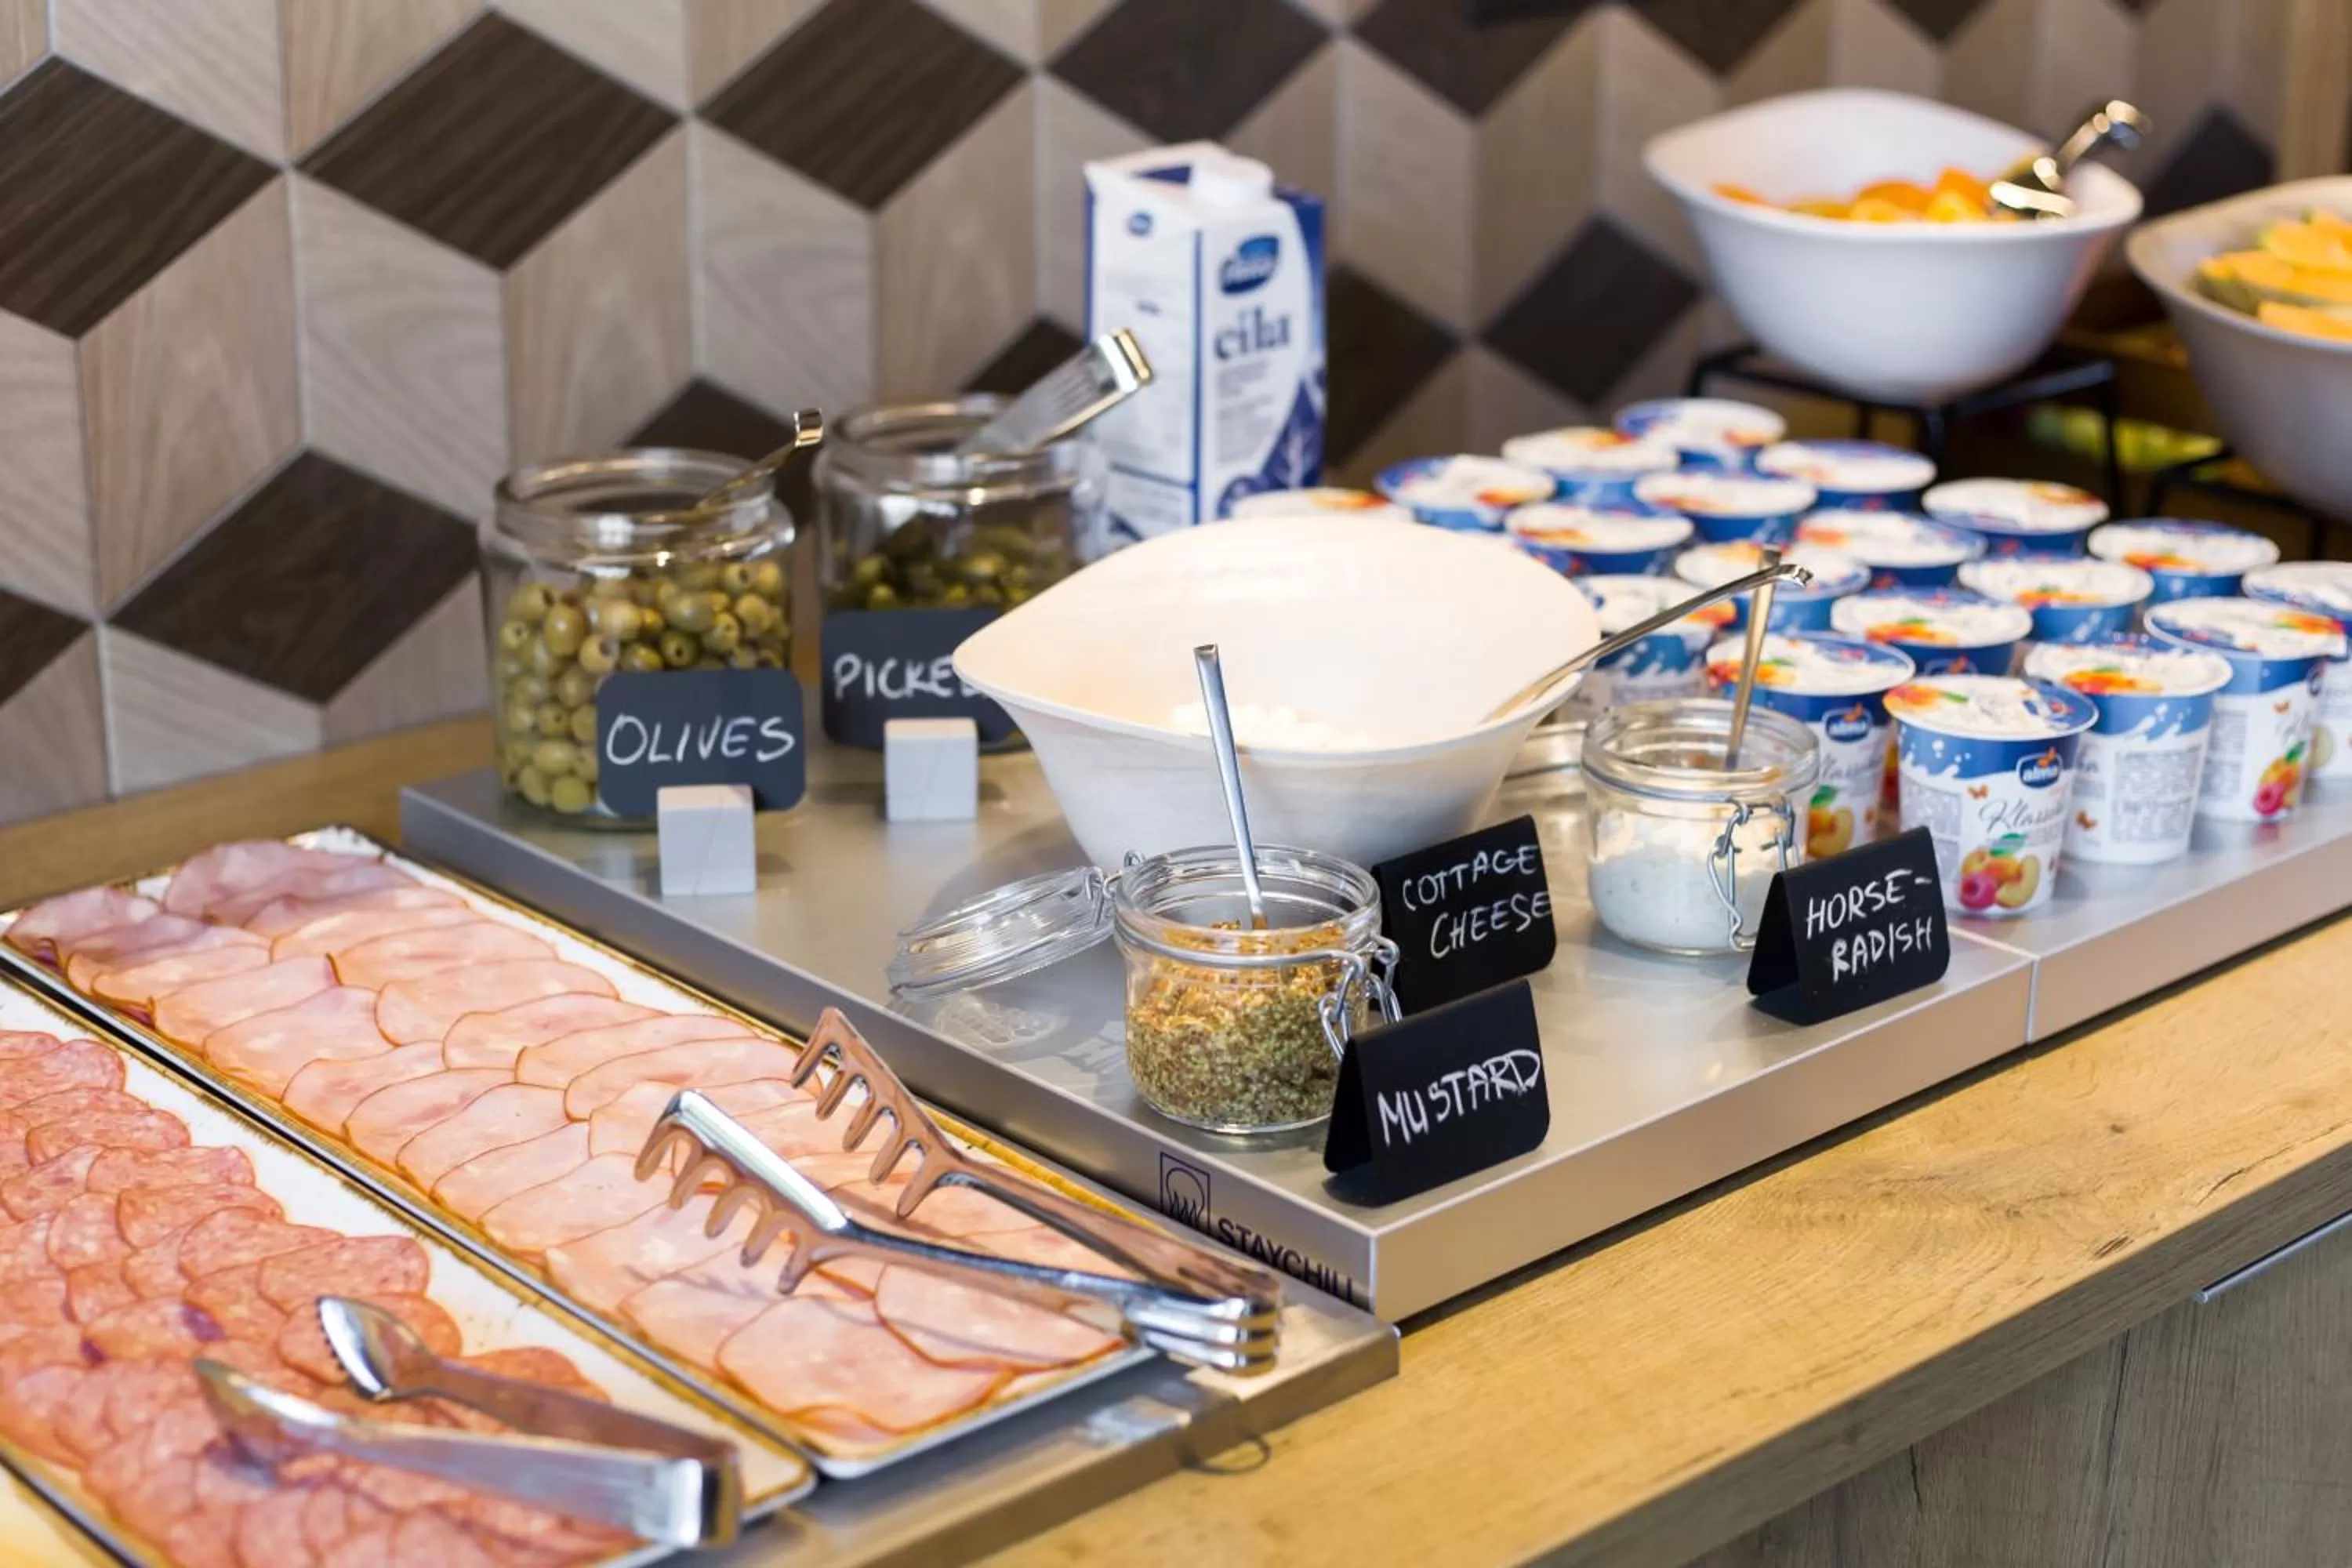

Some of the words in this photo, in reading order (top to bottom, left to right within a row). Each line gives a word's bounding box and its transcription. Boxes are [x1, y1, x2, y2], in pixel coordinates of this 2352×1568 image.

[604, 713, 795, 766] OLIVES
[1403, 844, 1539, 912] COTTAGE
[1430, 890, 1553, 960] CHEESE
[1831, 916, 1933, 982] RADISH
[1377, 1048, 1541, 1147] MUSTARD
